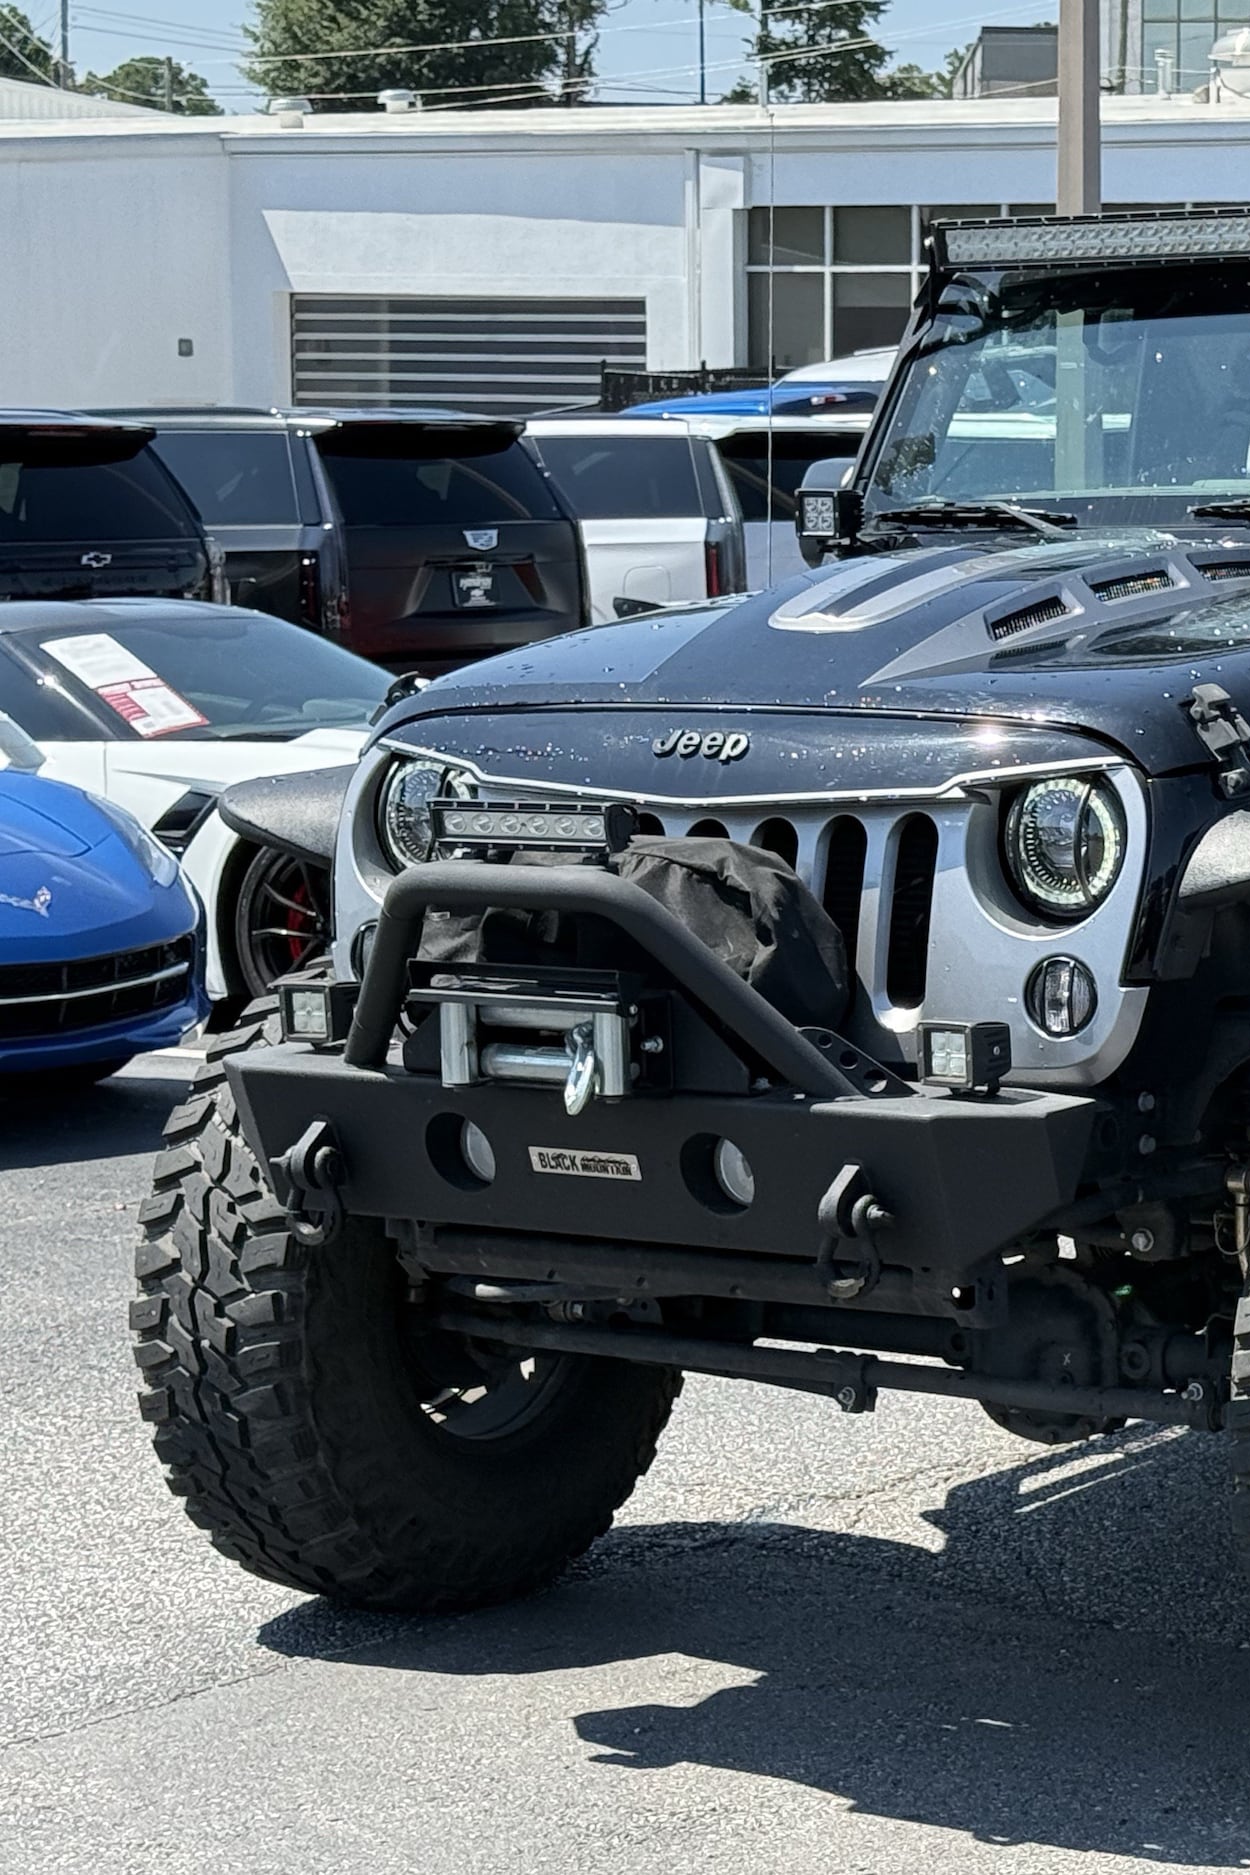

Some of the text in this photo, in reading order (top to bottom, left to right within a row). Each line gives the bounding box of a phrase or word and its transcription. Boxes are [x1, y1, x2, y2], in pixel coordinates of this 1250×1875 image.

[652, 729, 749, 763] Jeep
[538, 1151, 632, 1176] BLACK MOUNTAIN
